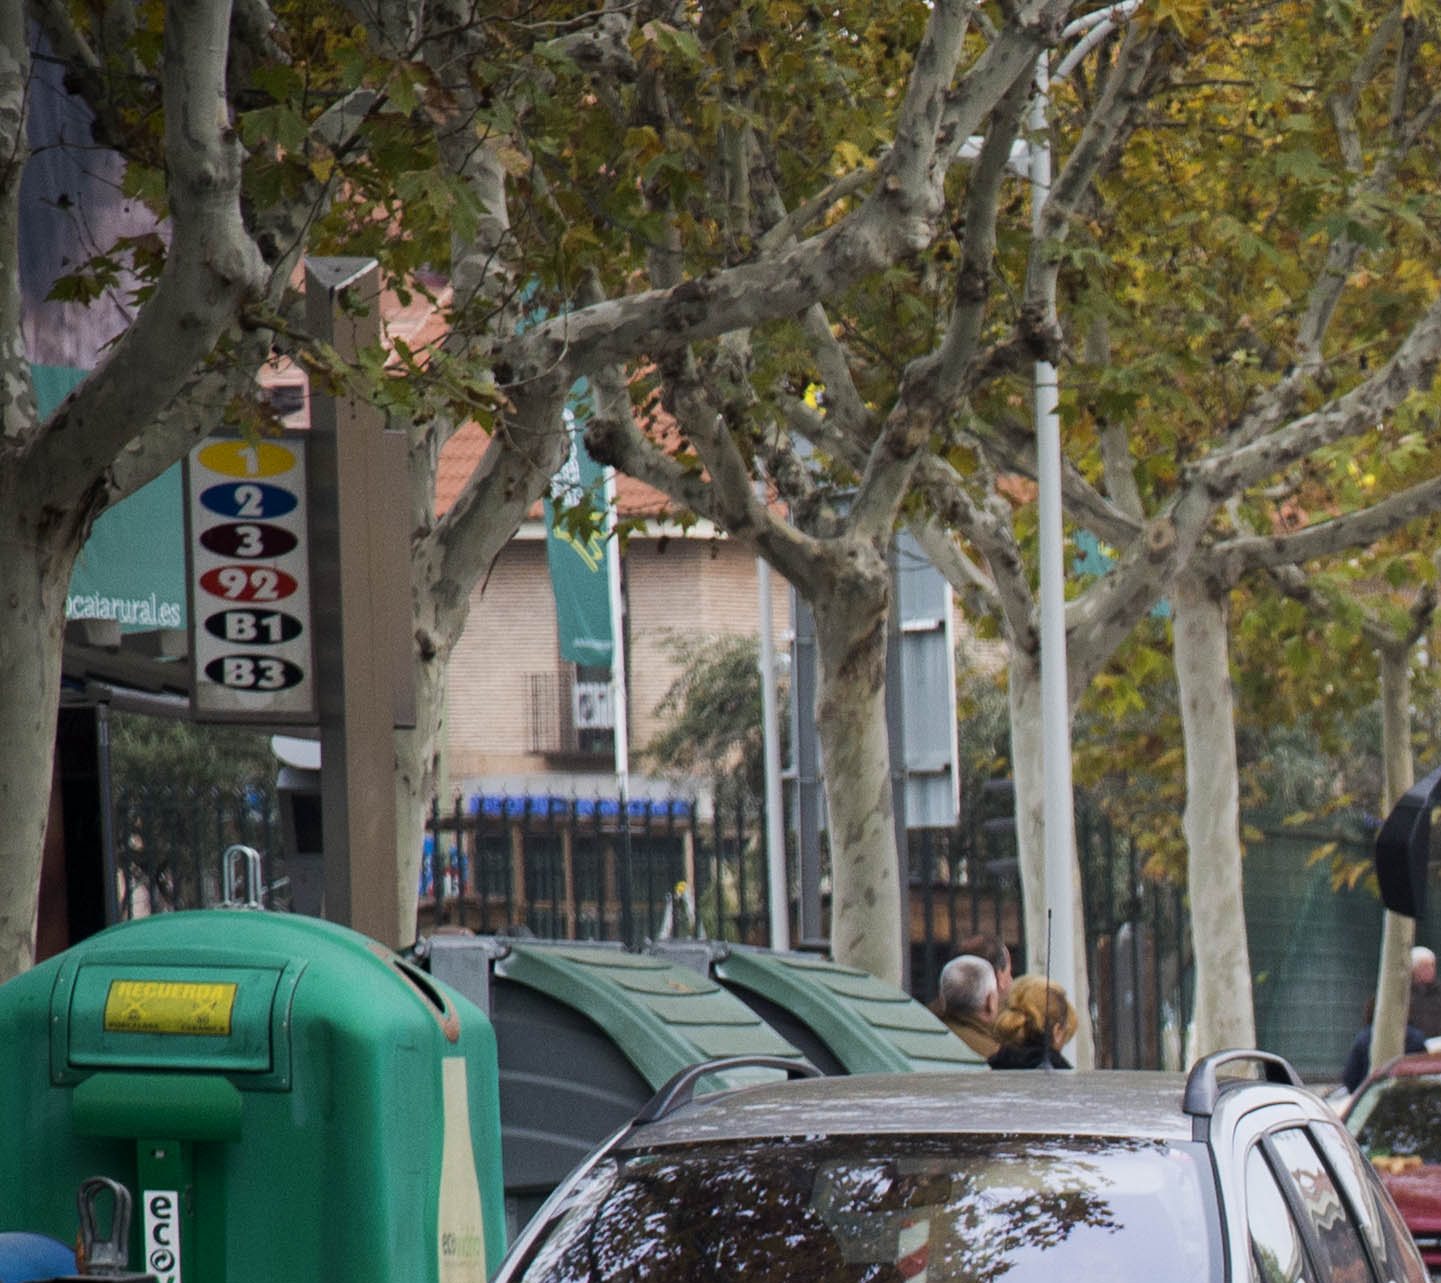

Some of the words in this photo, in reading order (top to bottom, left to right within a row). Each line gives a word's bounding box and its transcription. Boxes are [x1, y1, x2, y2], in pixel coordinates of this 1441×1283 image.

[237, 447, 260, 474] 1
[234, 485, 264, 517] 2
[234, 525, 264, 557] 3
[218, 568, 279, 600] 92
[226, 612, 283, 643] B1
[224, 657, 286, 688] B3
